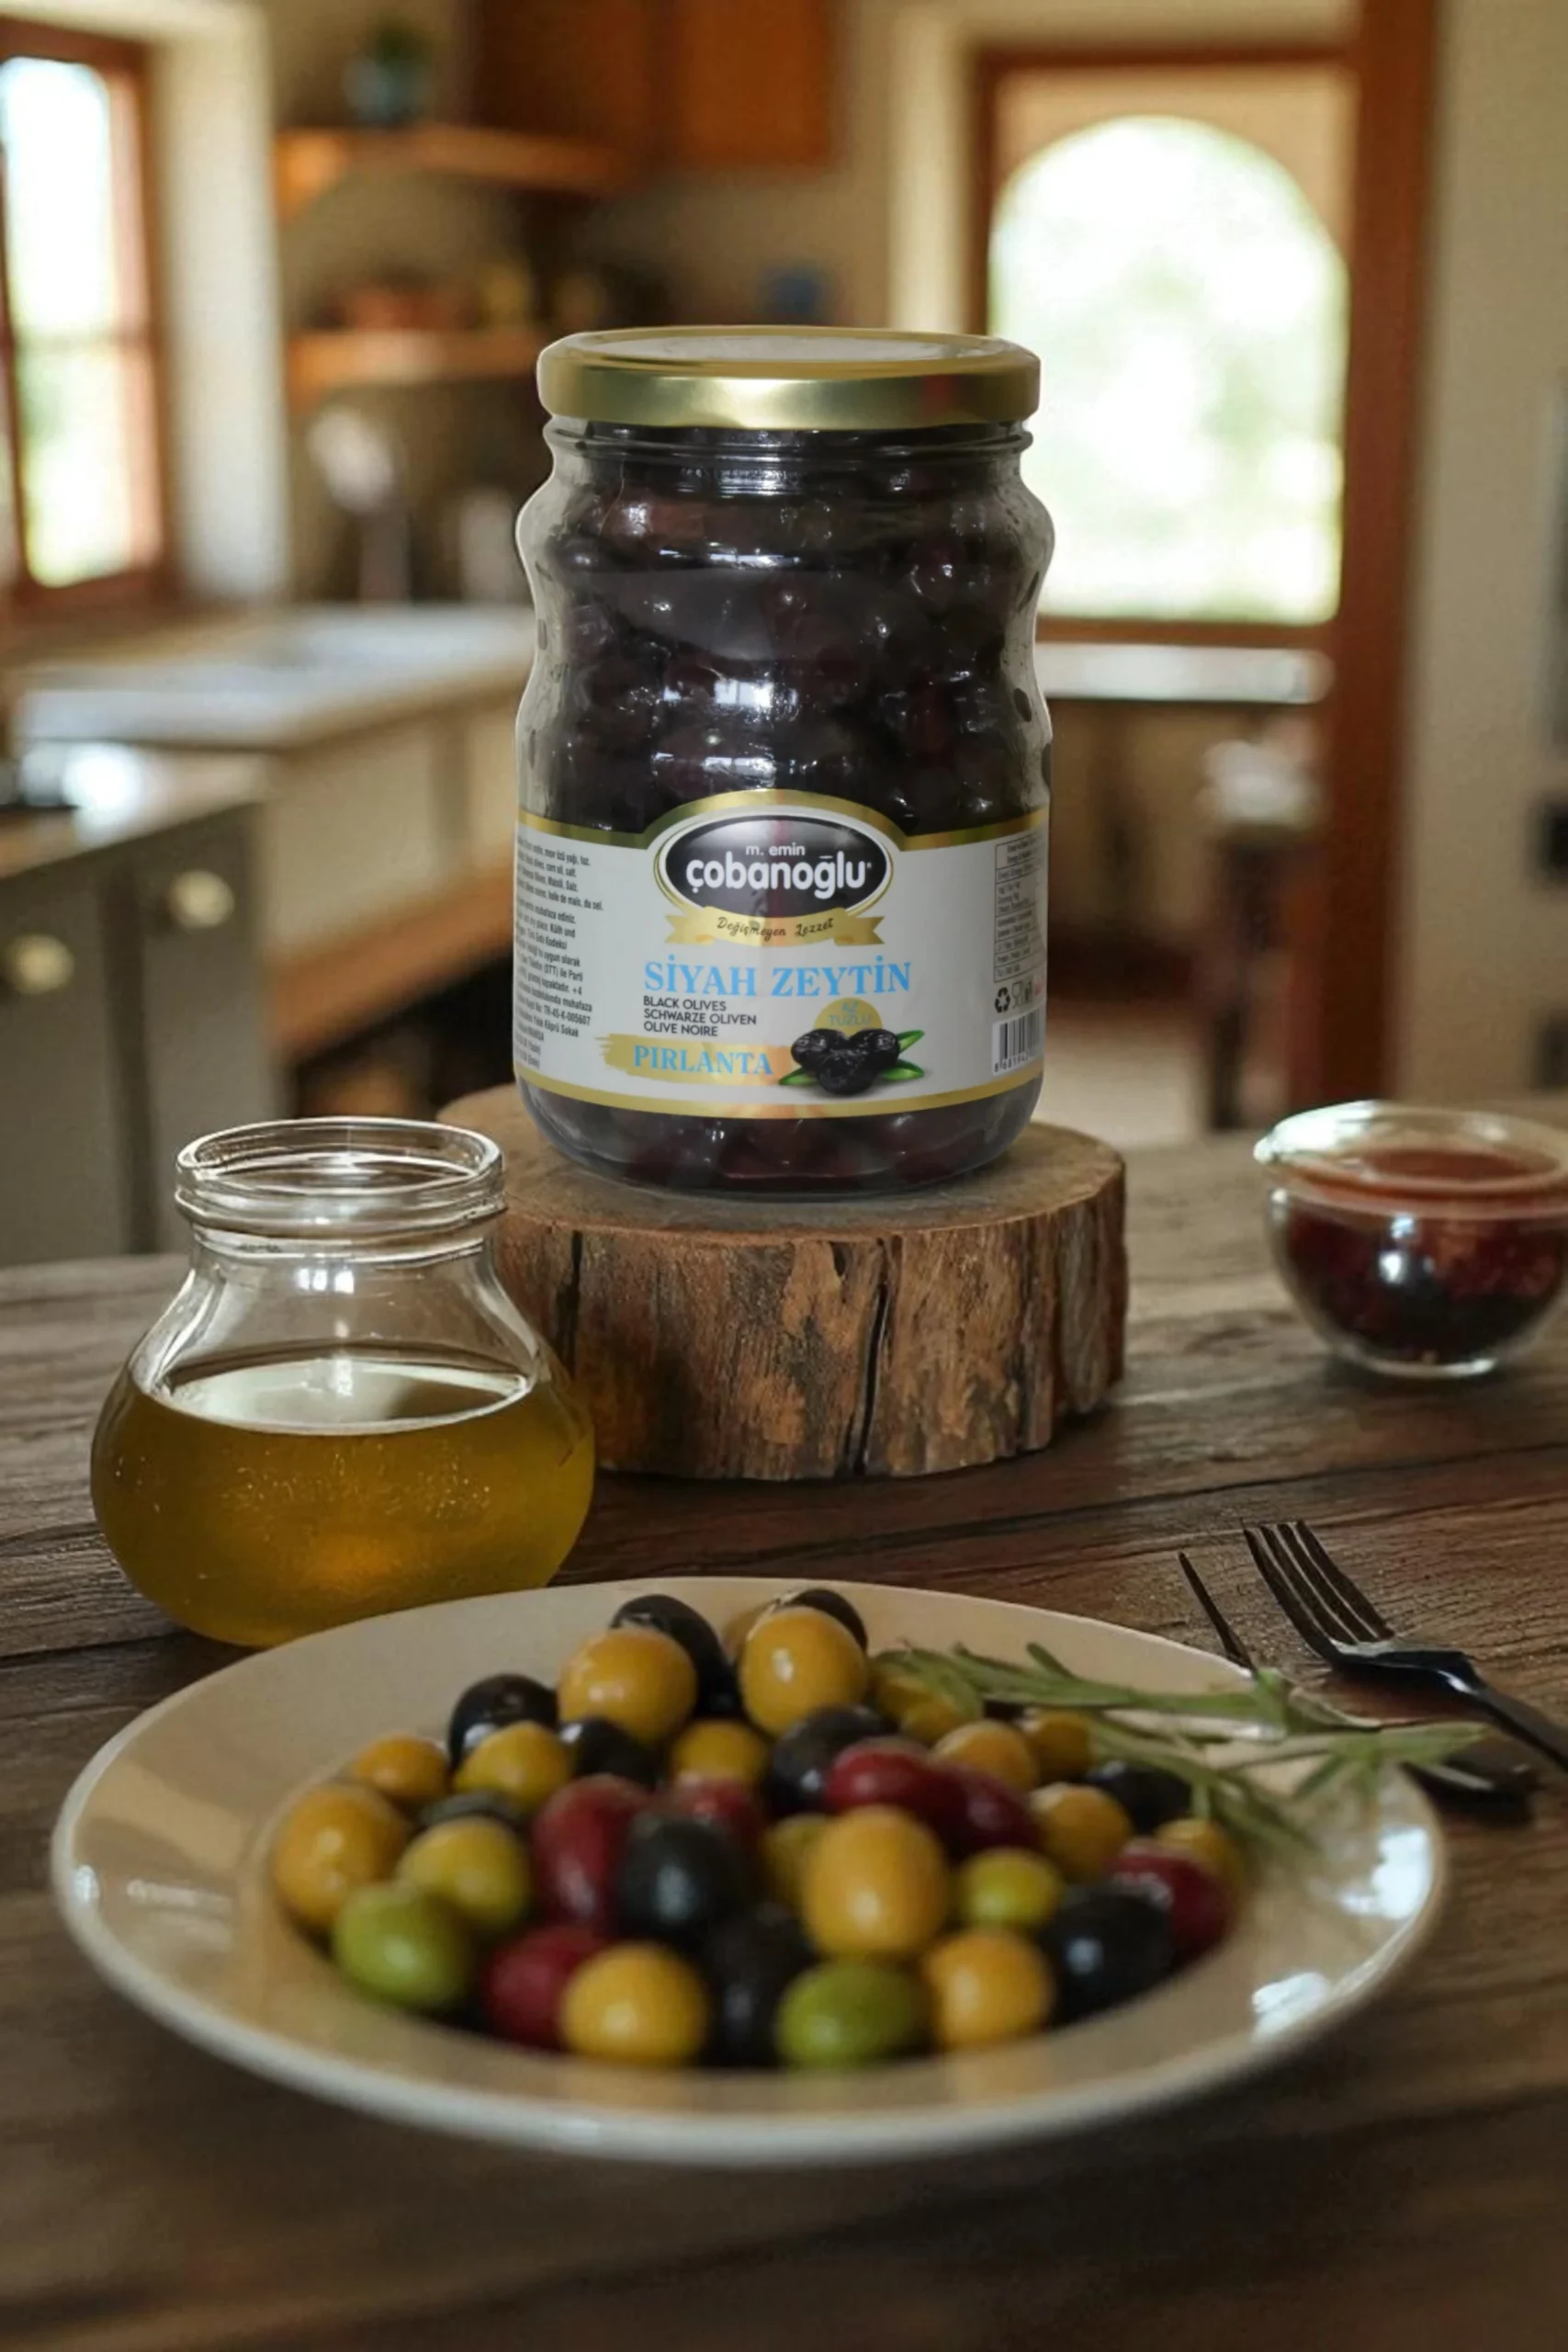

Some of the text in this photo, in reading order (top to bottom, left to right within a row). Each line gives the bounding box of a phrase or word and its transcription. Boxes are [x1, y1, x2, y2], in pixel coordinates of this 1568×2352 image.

[746, 842, 806, 856] m. emin
[686, 851, 866, 899] çobanoğlu
[716, 917, 834, 942] Değişmeyen Lezzet
[644, 954, 912, 997] SİYAH ZEYTİN
[643, 995, 727, 1012] BLACK OLIVES
[643, 1008, 757, 1026] SCHWARZE OLIVEN
[644, 1021, 718, 1037] OLIVE NOIRE
[634, 1044, 773, 1076] PIRLANTA
